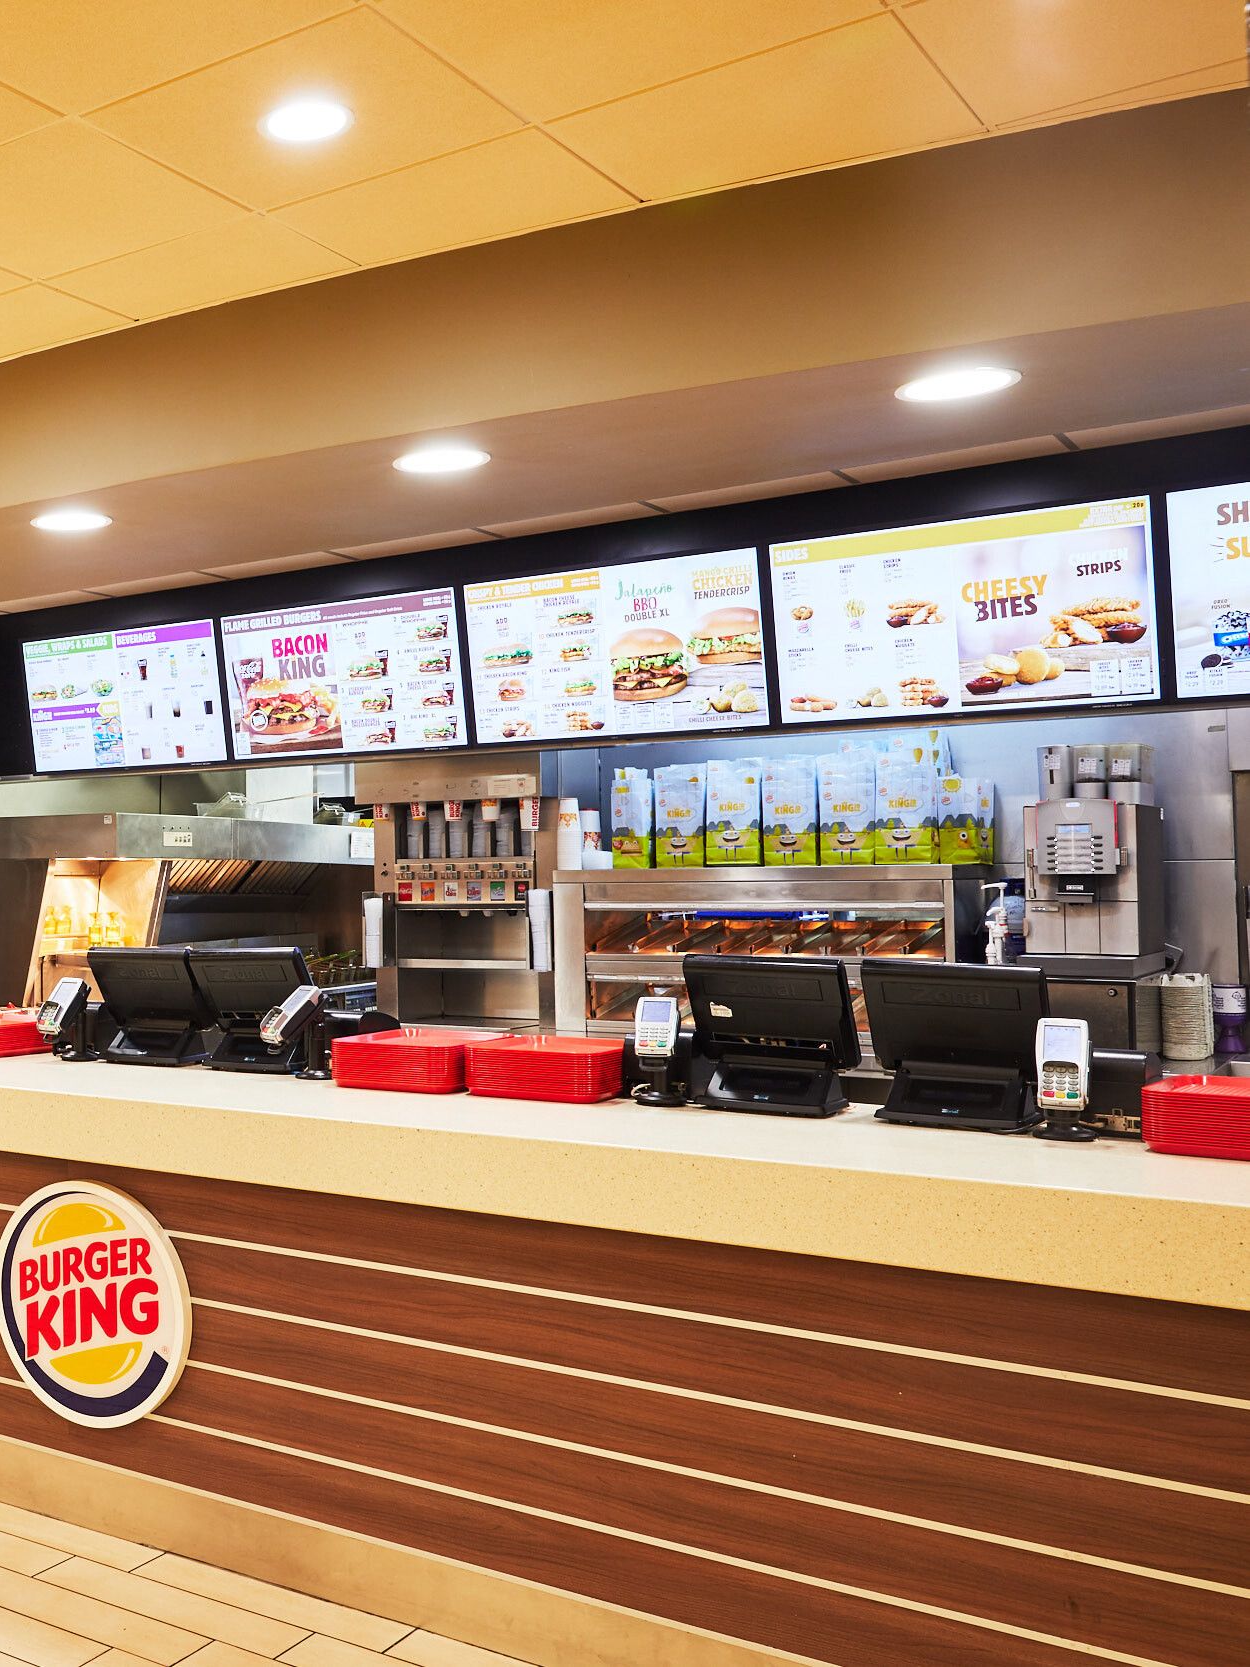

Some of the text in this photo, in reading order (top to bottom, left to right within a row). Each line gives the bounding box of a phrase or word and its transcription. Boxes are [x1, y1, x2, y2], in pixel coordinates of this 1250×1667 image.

[775, 548, 808, 563] SIDES
[1076, 560, 1122, 577] STRIPS
[615, 579, 674, 600] Jalapeño
[692, 574, 753, 591] CHICKEN
[961, 574, 1048, 603] CHEESY
[694, 586, 750, 600] TENDERCRISP
[633, 597, 657, 612] BBQ
[974, 593, 1038, 622] BITES
[224, 610, 321, 632] FLAME GRILLED BURGERS
[624, 608, 670, 623] DOUBLE XL
[116, 631, 157, 645] BEVERAGES
[271, 633, 328, 658] BACON
[278, 654, 326, 680] KING
[719, 801, 739, 812] KING
[774, 804, 793, 815] KING
[833, 802, 854, 812] KING
[888, 797, 910, 809] KING
[19, 1237, 152, 1301] BURGER
[26, 1277, 159, 1359] KING
